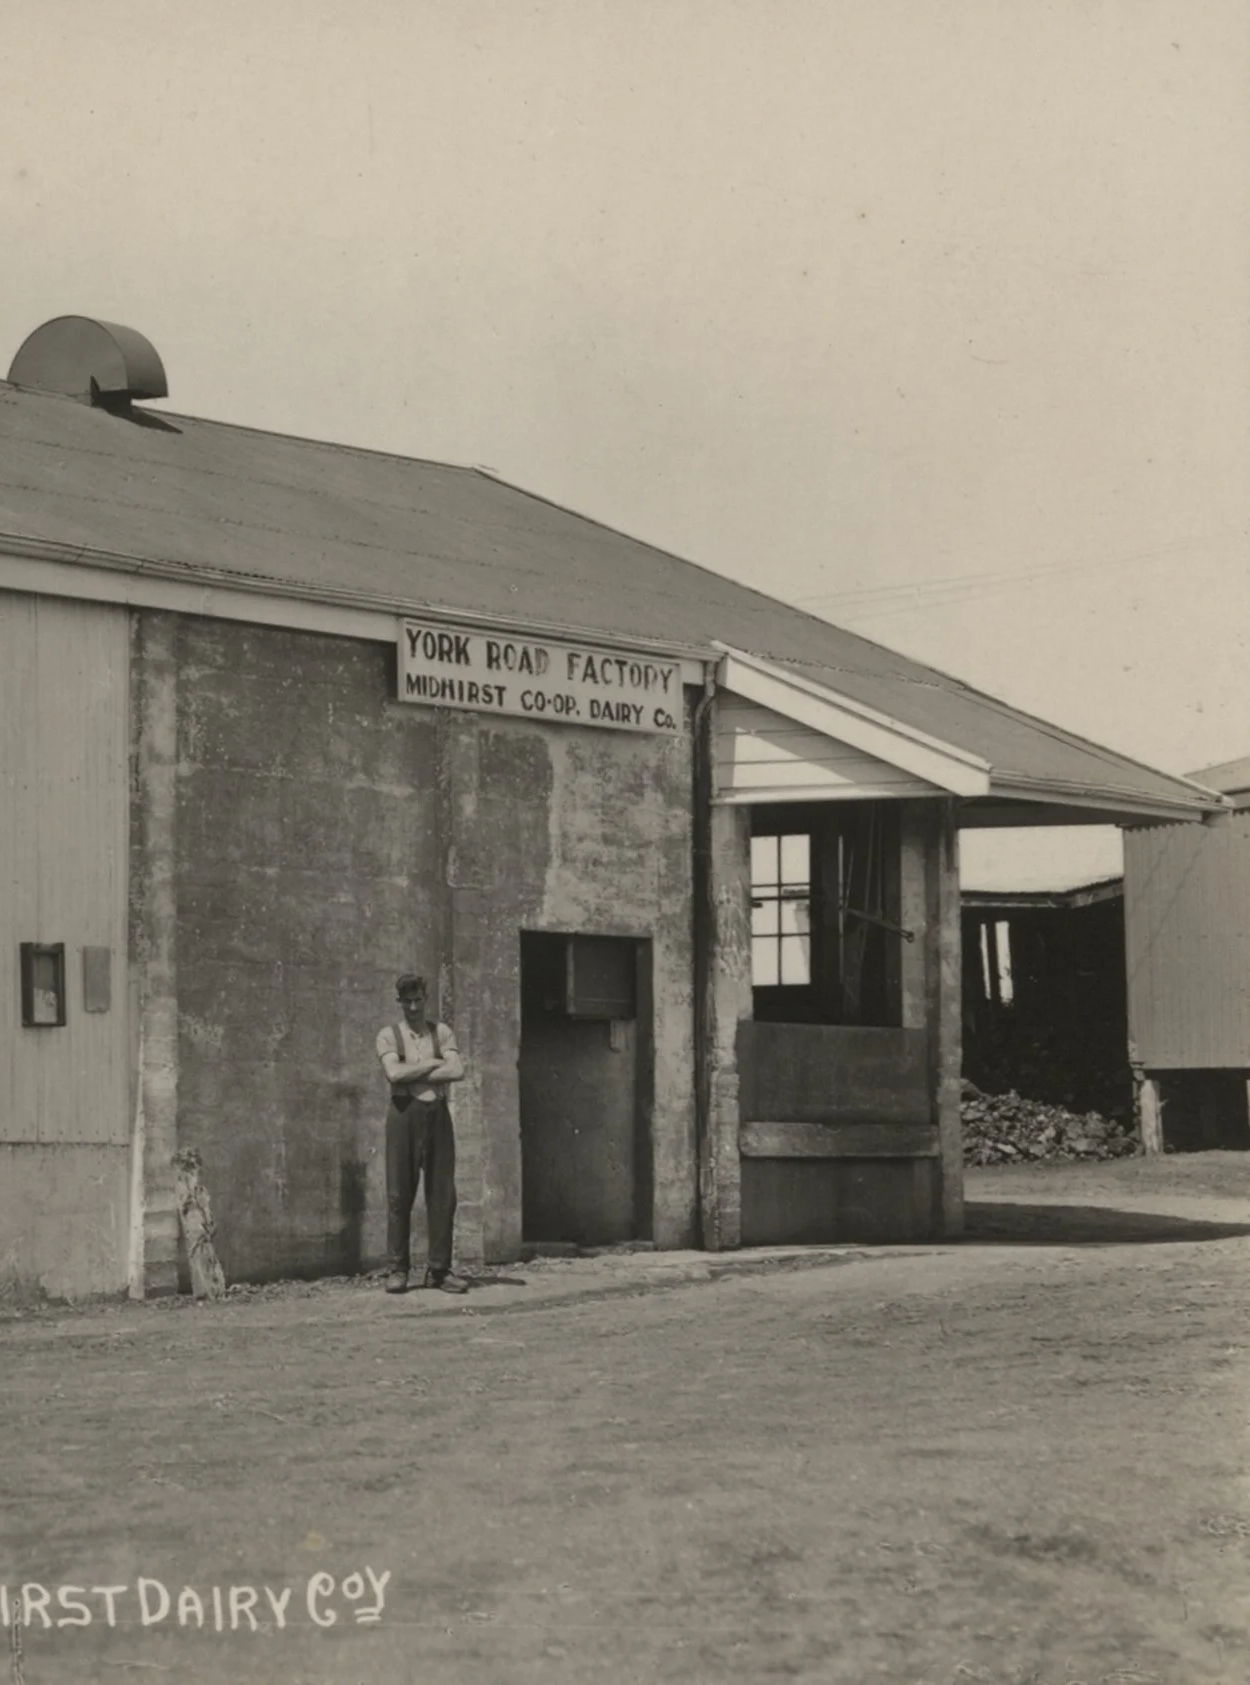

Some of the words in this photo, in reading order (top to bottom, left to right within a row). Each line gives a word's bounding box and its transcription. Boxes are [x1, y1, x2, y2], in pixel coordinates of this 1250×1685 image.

[405, 627, 471, 667] YORK
[486, 640, 550, 676] ROAD
[567, 652, 673, 694] FACTORY
[405, 672, 507, 708] MIDHIRST
[589, 701, 645, 726] DAIRY
